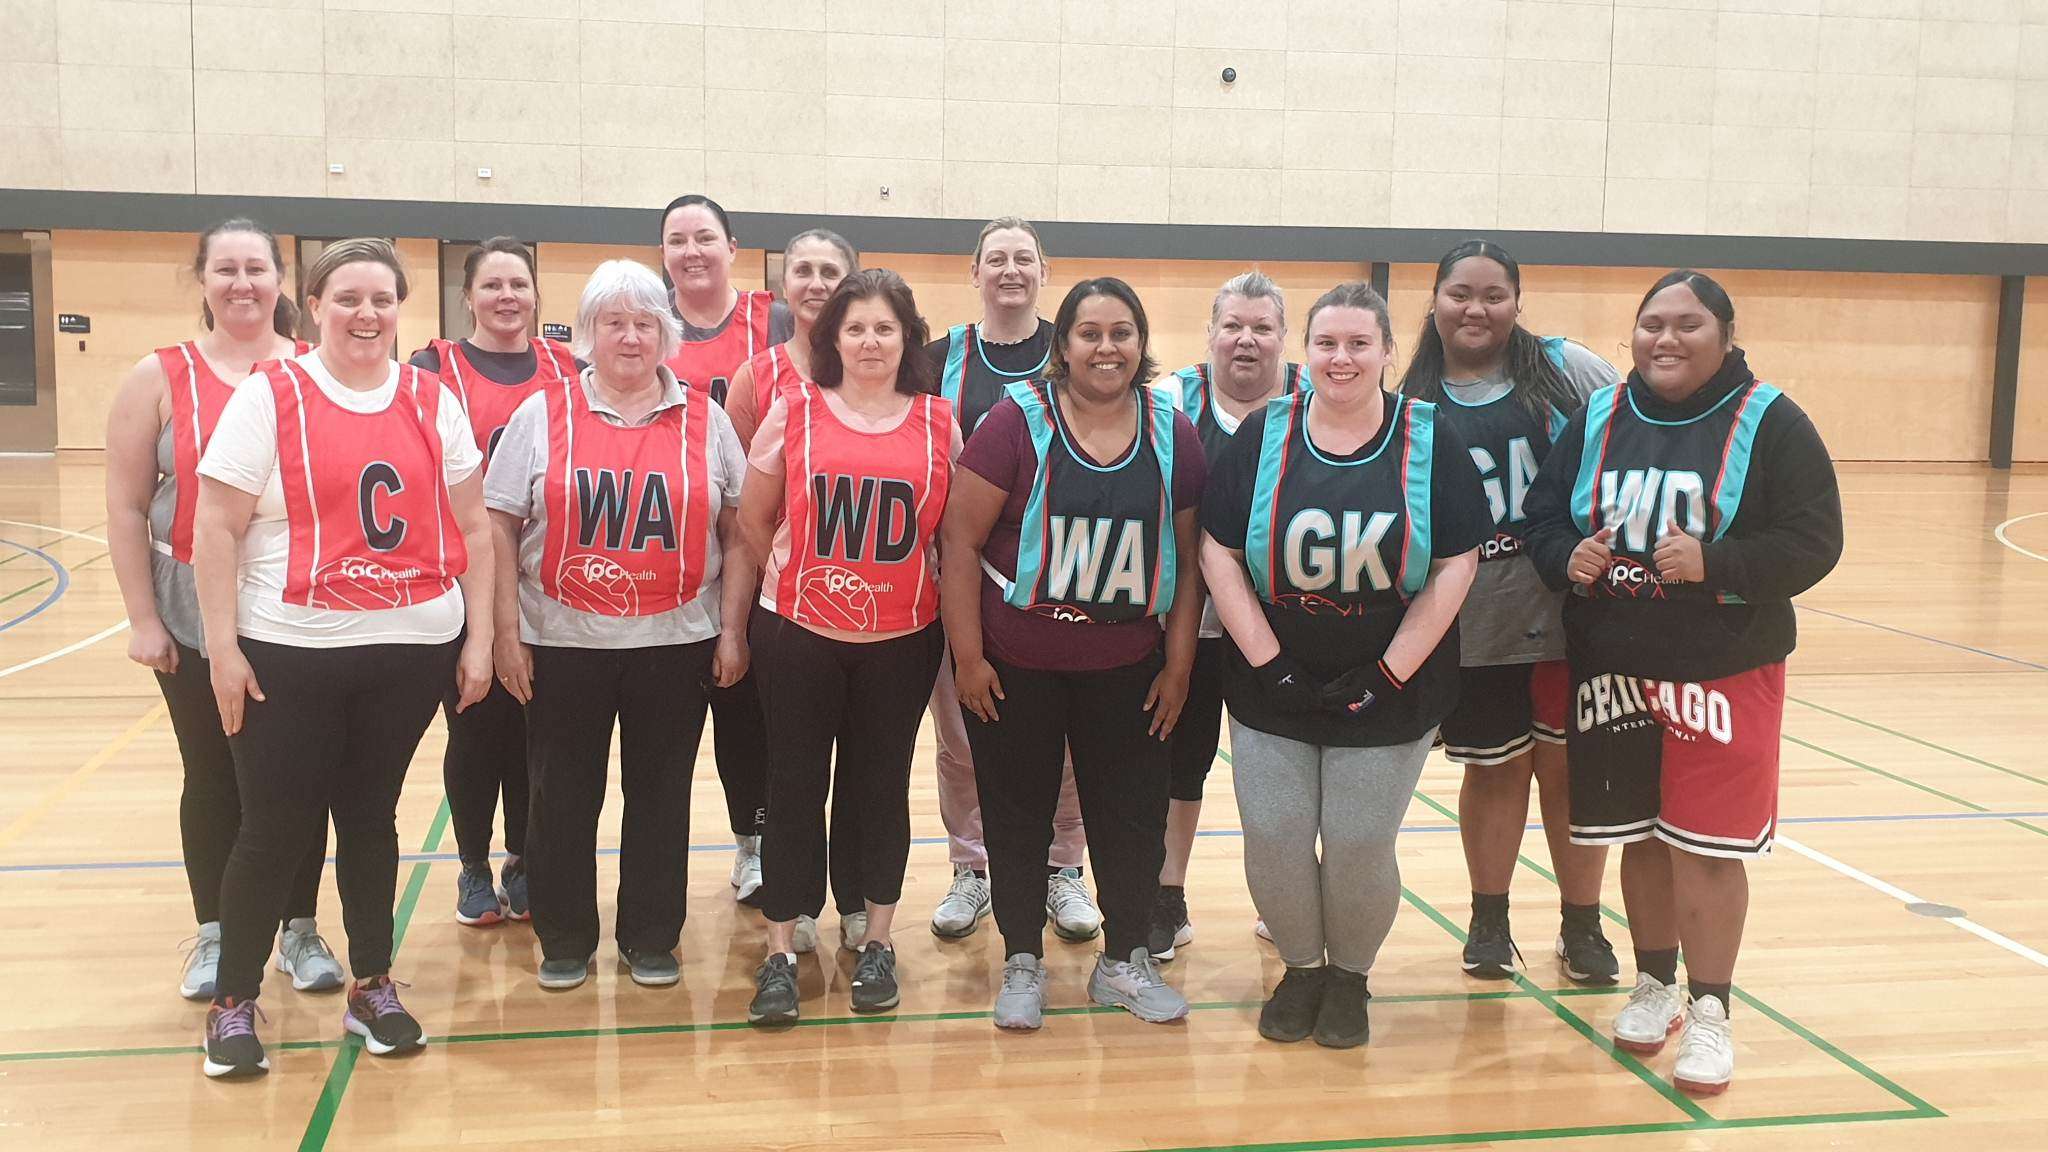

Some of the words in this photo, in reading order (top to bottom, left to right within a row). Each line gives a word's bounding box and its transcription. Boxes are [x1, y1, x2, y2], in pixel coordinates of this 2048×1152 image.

[358, 460, 408, 552] C
[574, 467, 679, 552] WA
[812, 473, 919, 564] WD
[1601, 467, 1706, 553] WD
[620, 568, 657, 581] Health
[858, 580, 894, 593] Health
[1048, 515, 1147, 606] WA
[1284, 508, 1398, 593] GK
[1577, 672, 1733, 745] CHICAGO
